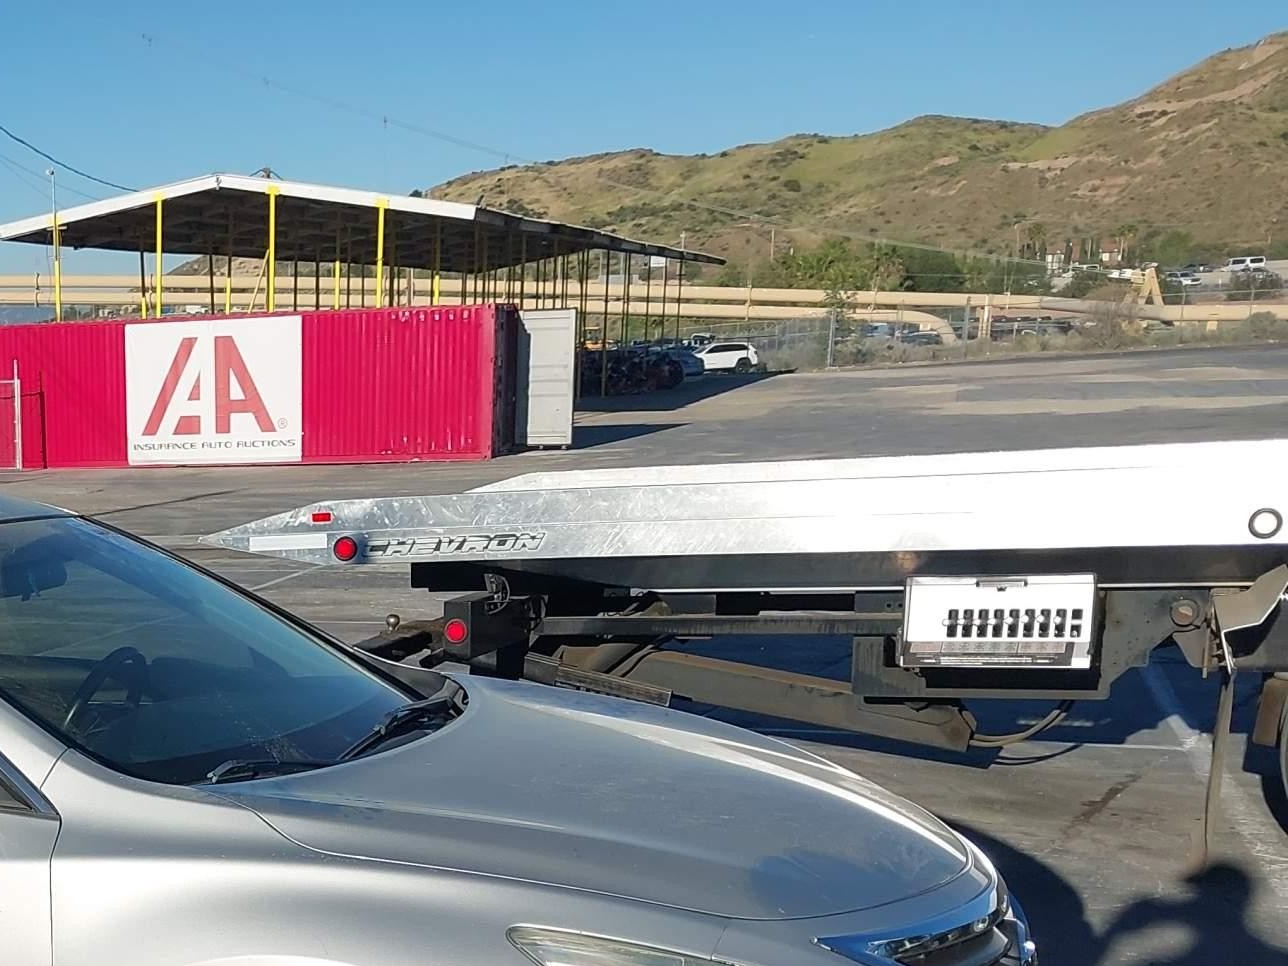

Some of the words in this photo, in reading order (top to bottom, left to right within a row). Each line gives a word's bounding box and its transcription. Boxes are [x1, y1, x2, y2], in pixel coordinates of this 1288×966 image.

[133, 441, 197, 451] INSURANCE
[201, 440, 233, 449] AUTO
[236, 438, 296, 448] AUCTIONS
[364, 532, 546, 557] CHEVRON
